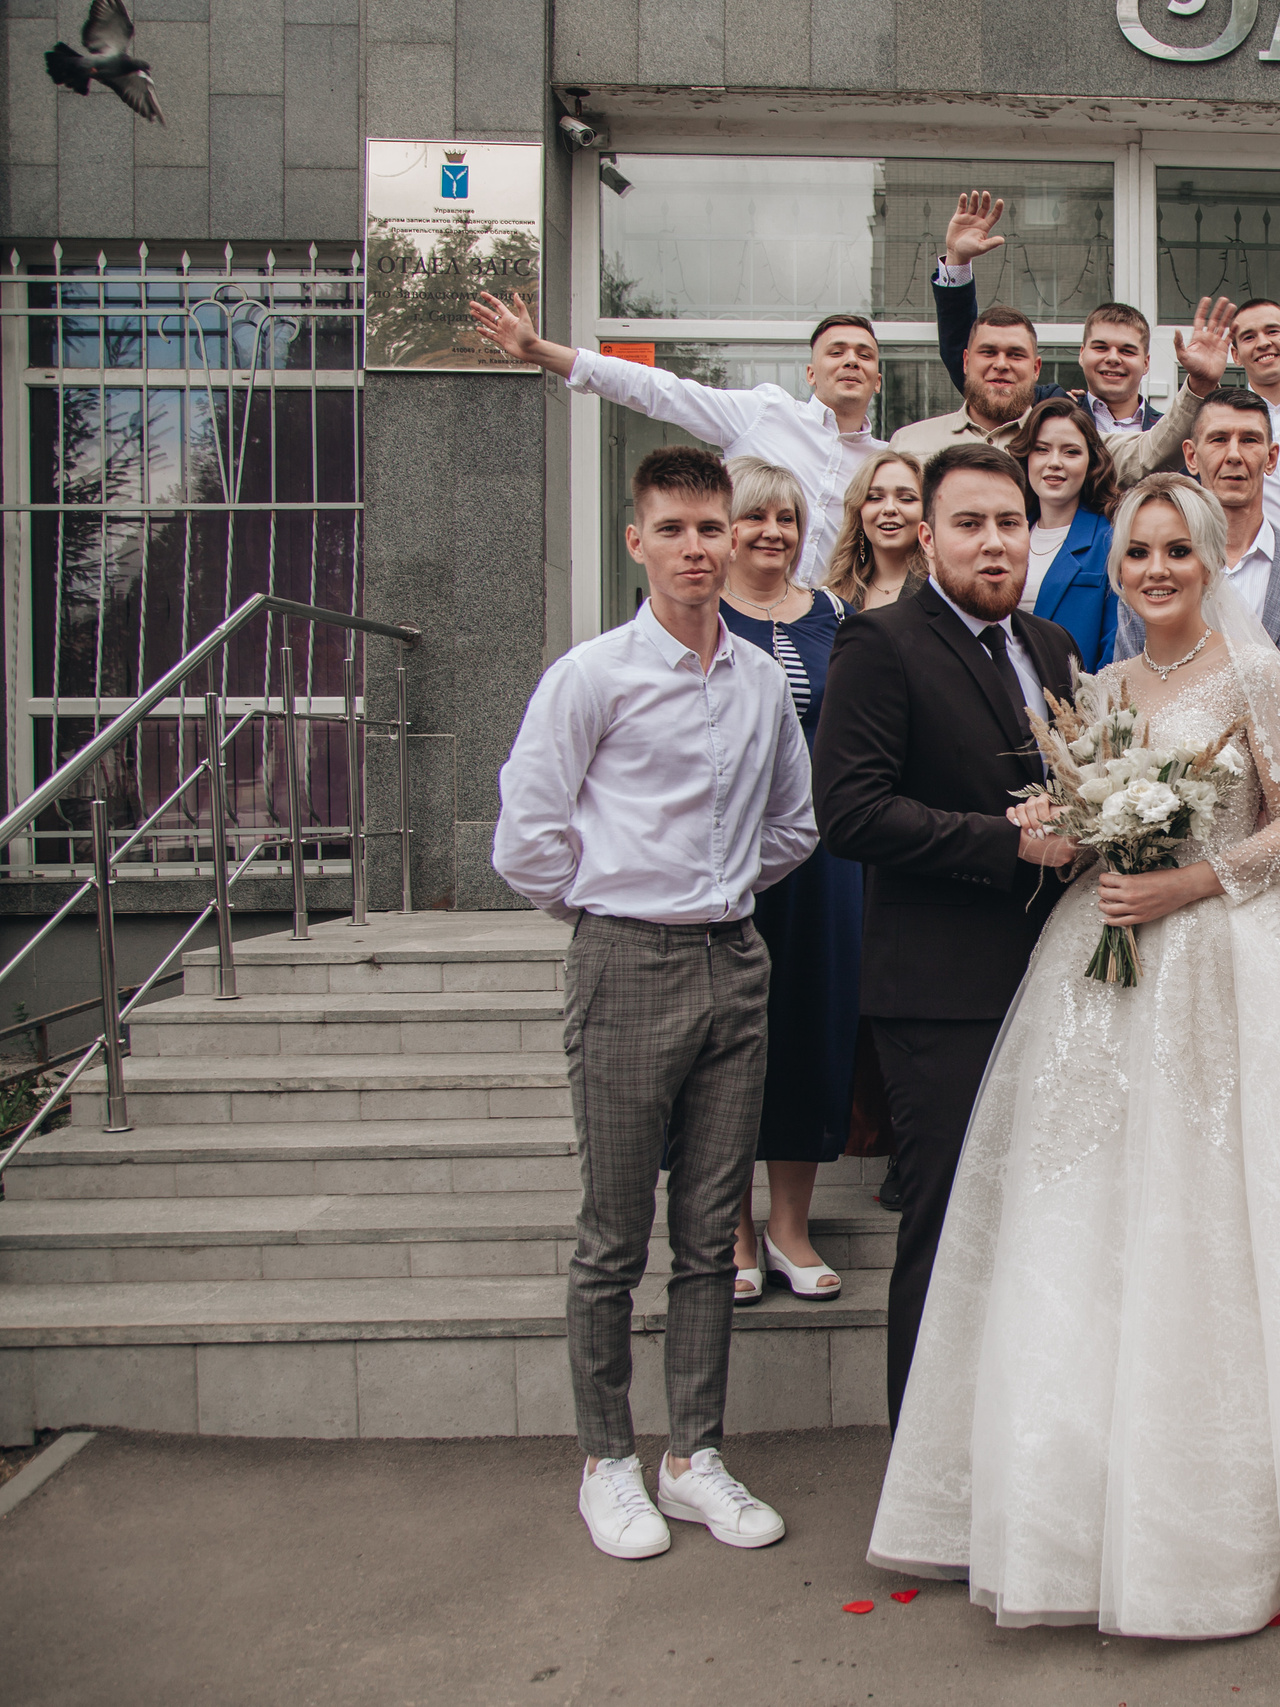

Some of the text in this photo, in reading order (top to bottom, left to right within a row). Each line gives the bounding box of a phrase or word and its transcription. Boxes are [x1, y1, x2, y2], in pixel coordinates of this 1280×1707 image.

[383, 216, 405, 224] делам
[391, 226, 443, 234] Правительства
[377, 256, 531, 278] ОТДЕЛ ЗАГС
[373, 290, 391, 299] по
[395, 287, 478, 303] Заводскому
[413, 310, 478, 323] г. Сарато
